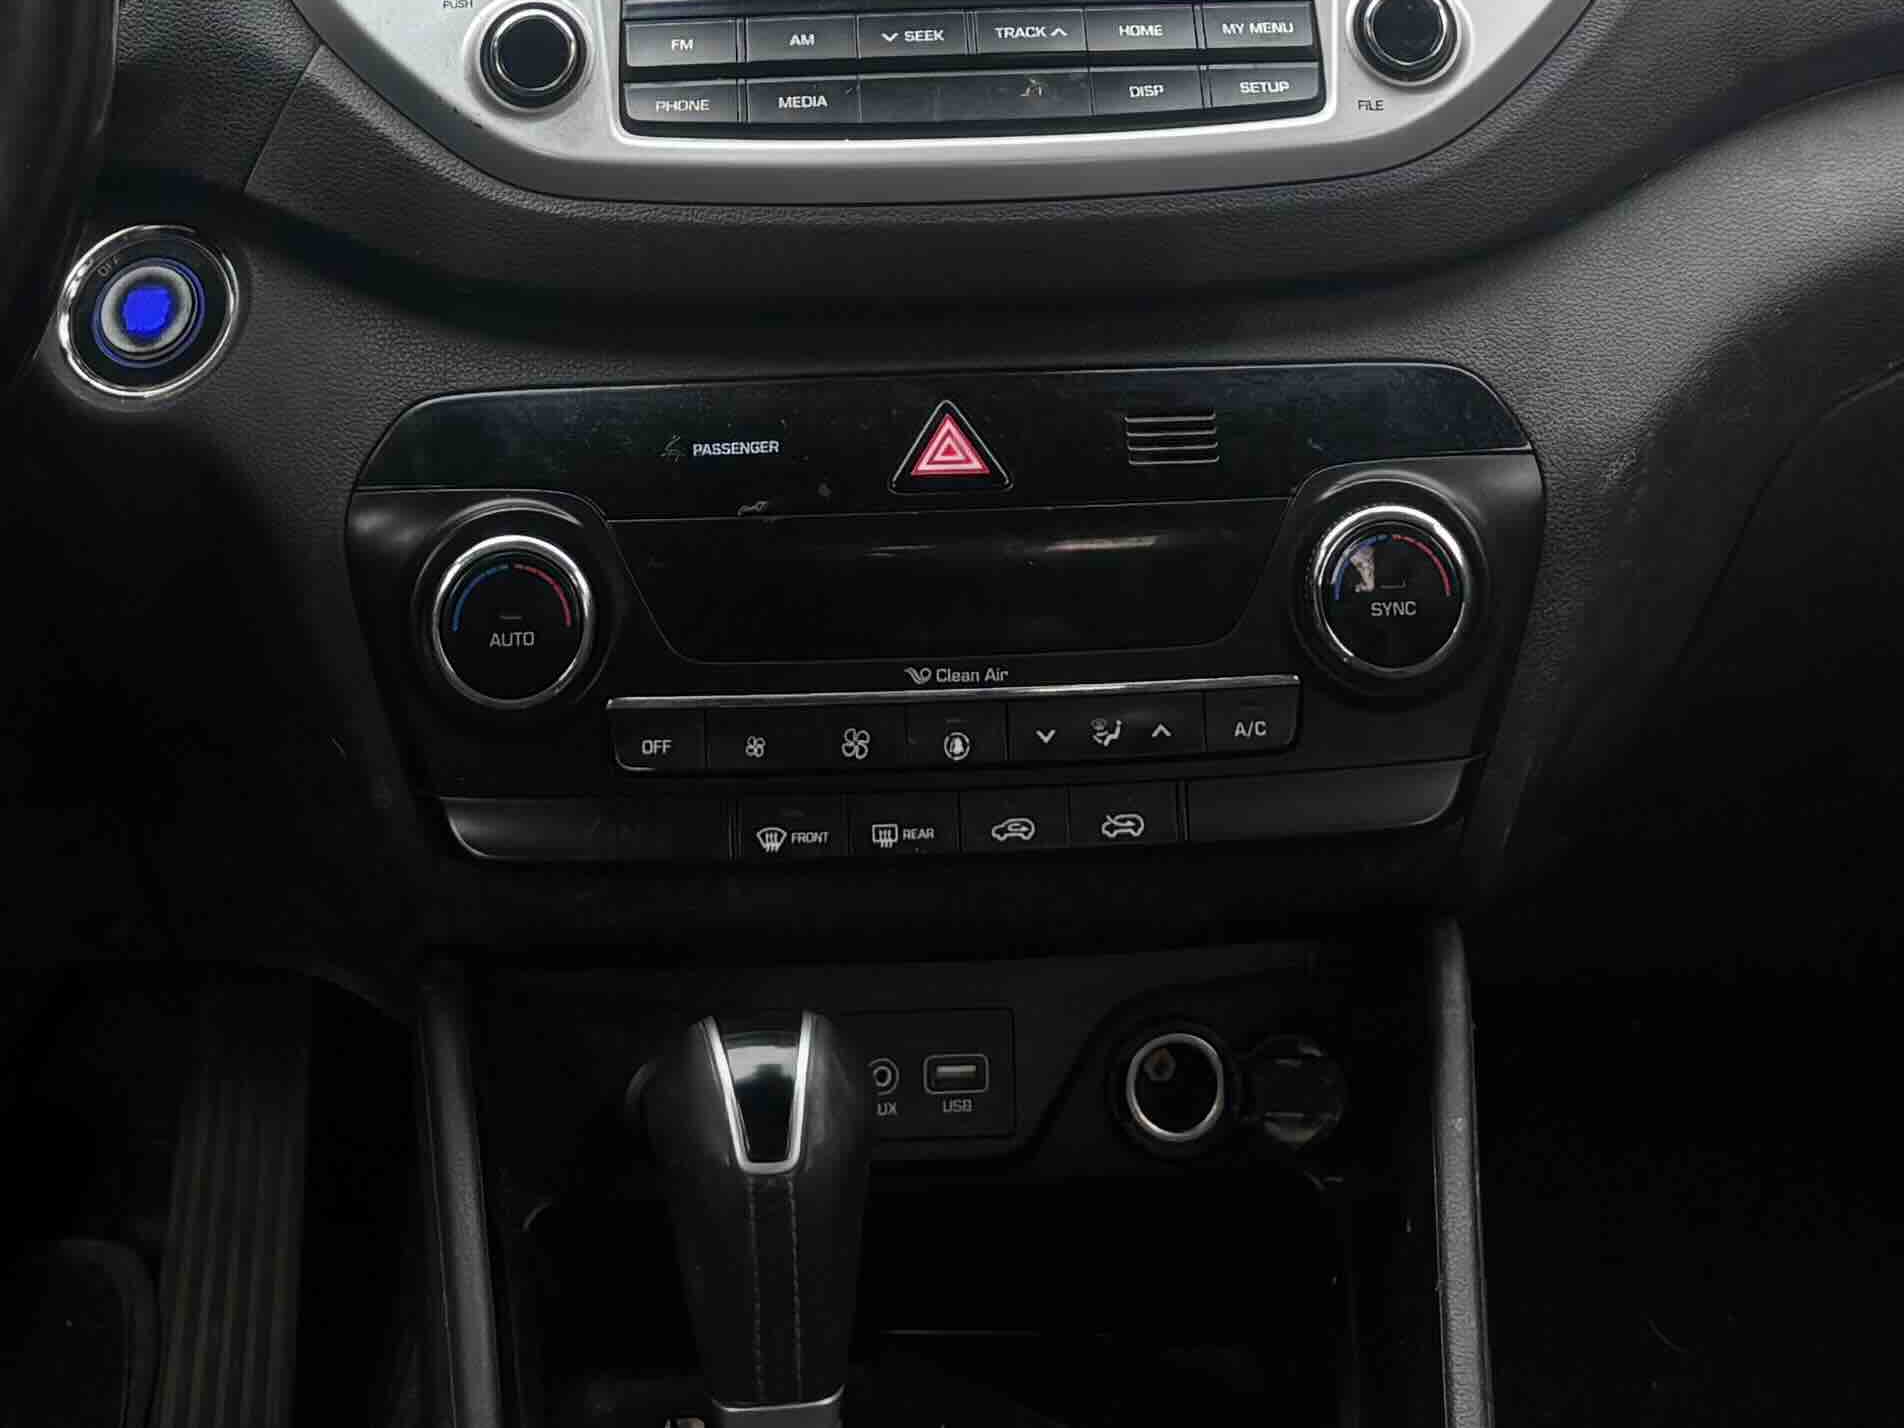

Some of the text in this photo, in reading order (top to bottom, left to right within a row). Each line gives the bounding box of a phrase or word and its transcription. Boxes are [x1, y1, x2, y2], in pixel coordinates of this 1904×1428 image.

[904, 29, 945, 43] SEEK
[995, 26, 1047, 40] TRACK
[1118, 23, 1164, 38] HOME
[1222, 21, 1295, 36] MY MENU
[671, 38, 695, 51] FM
[789, 33, 816, 47] AM
[1129, 83, 1165, 99] DISP
[1239, 80, 1290, 95] SETUP
[655, 98, 710, 113] PHONE
[778, 94, 829, 110] MEDIA
[1357, 99, 1385, 112] FILE
[692, 440, 780, 457] PASSENGER
[1370, 600, 1417, 617] SYNC
[489, 631, 535, 648] AUTO
[935, 667, 1008, 683] Clean Air
[1234, 720, 1267, 739] A/C
[641, 739, 672, 755] OFF
[791, 831, 830, 844] FRONT
[903, 827, 935, 841] REAR
[876, 1102, 898, 1116] UX
[943, 1099, 973, 1113] USB
